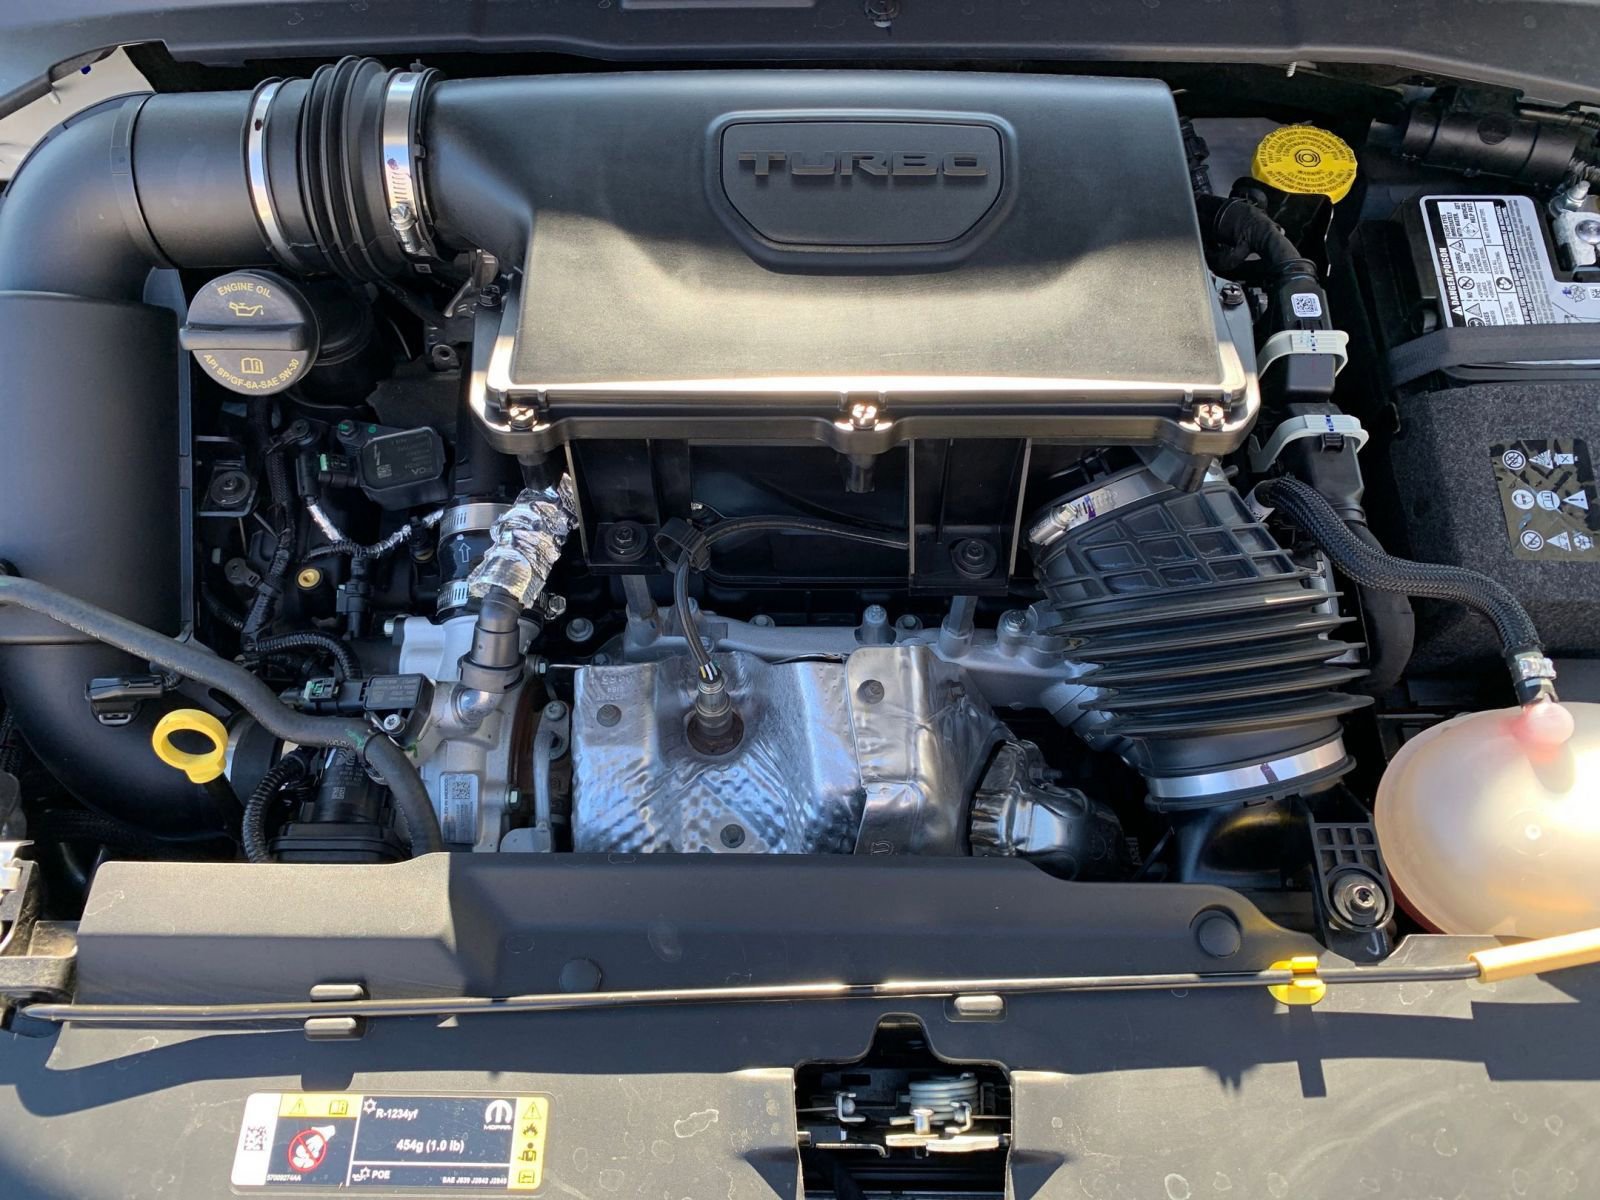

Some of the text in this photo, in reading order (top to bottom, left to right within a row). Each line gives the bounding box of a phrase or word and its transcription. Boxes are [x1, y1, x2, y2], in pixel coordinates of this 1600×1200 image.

[738, 151, 989, 177] TURBO
[1439, 248, 1459, 305] DANGER/POISON
[217, 282, 272, 298] ENGINE OIL
[204, 354, 300, 389] API SP/GF-6A-SAE 5W-30
[375, 1108, 418, 1121] R-1234yf
[396, 1139, 465, 1154] 454g (1.0 lb)
[371, 1170, 390, 1180] POE
